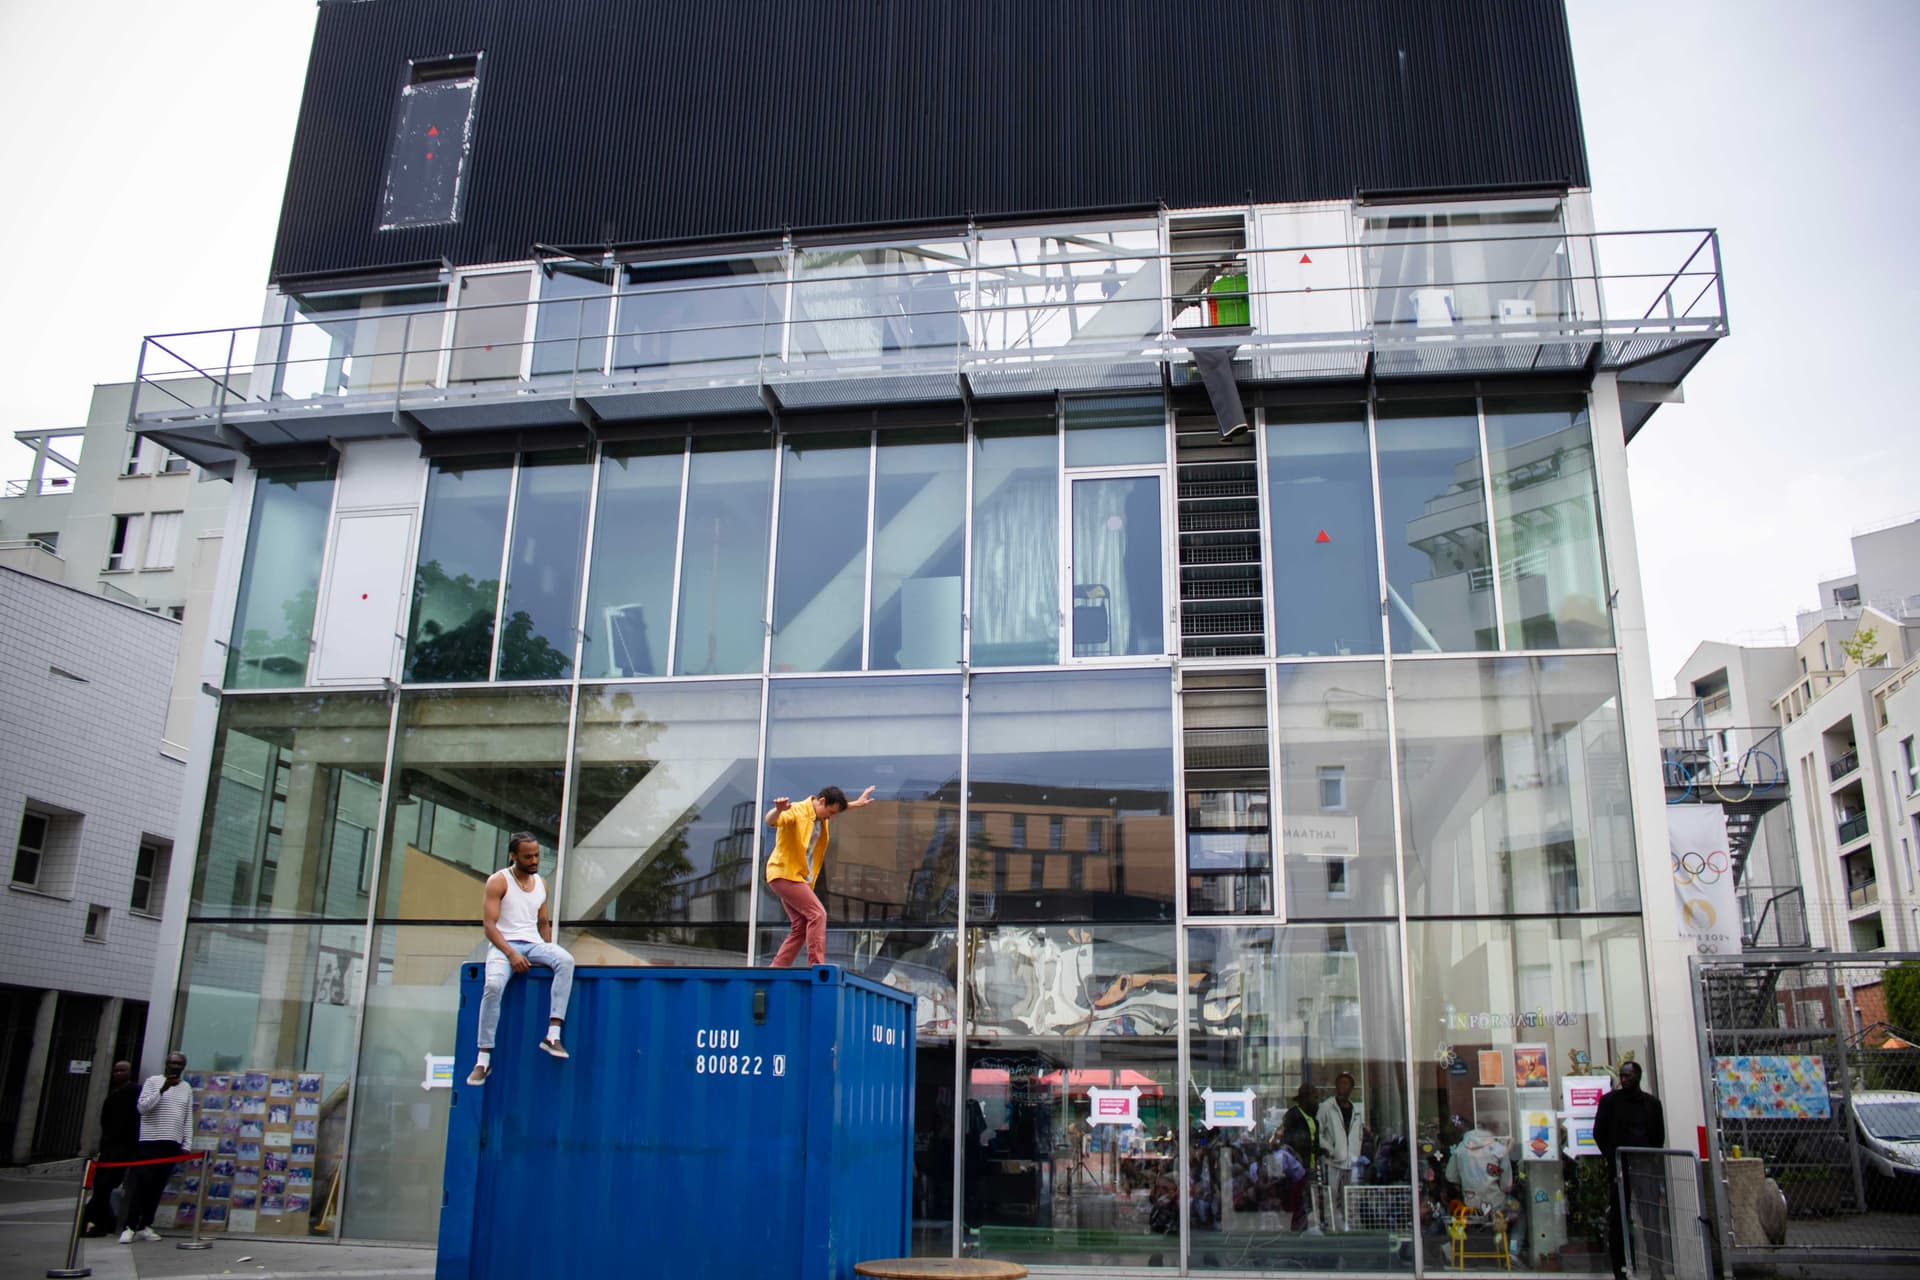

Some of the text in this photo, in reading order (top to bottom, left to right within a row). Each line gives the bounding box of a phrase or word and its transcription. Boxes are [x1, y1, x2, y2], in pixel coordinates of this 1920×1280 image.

[696, 1029, 740, 1049] CUBU
[696, 1055, 785, 1076] 800822 0
